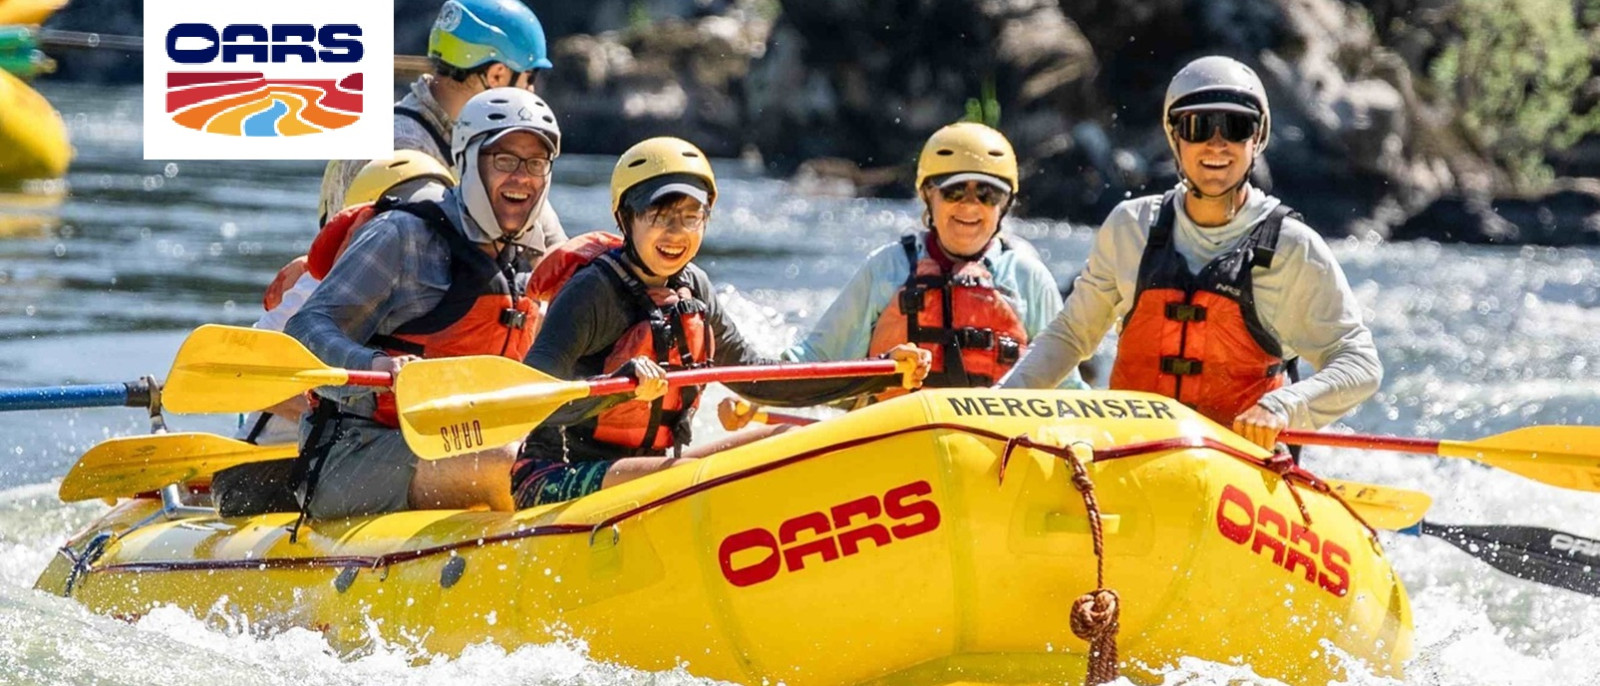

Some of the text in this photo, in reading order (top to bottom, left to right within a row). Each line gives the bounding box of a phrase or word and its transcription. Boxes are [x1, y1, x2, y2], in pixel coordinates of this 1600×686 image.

[947, 397, 1176, 420] MERGANSER
[718, 480, 941, 588] OARS
[1216, 483, 1352, 598] OARS
